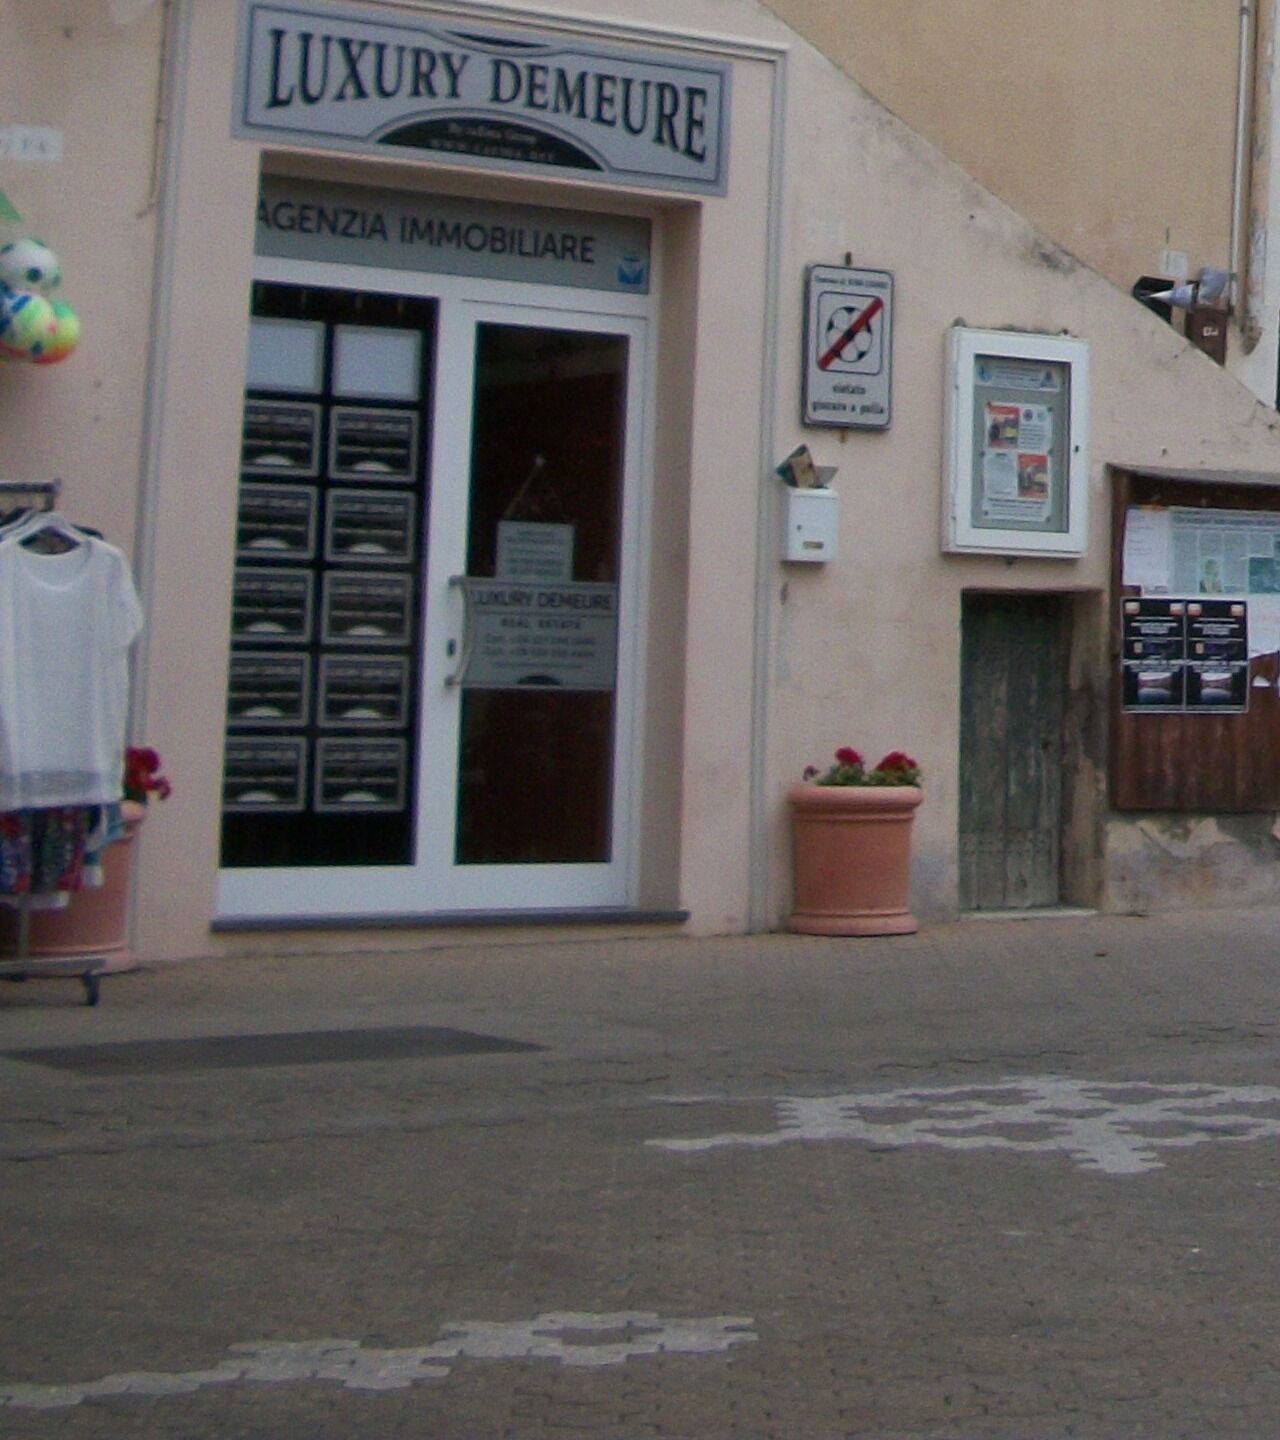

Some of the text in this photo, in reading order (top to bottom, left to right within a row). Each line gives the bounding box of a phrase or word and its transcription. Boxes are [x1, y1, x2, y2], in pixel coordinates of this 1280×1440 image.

[266, 28, 708, 162] LUXURY DEMEURE
[257, 197, 596, 263] AGENZIA IMMOBILIARE
